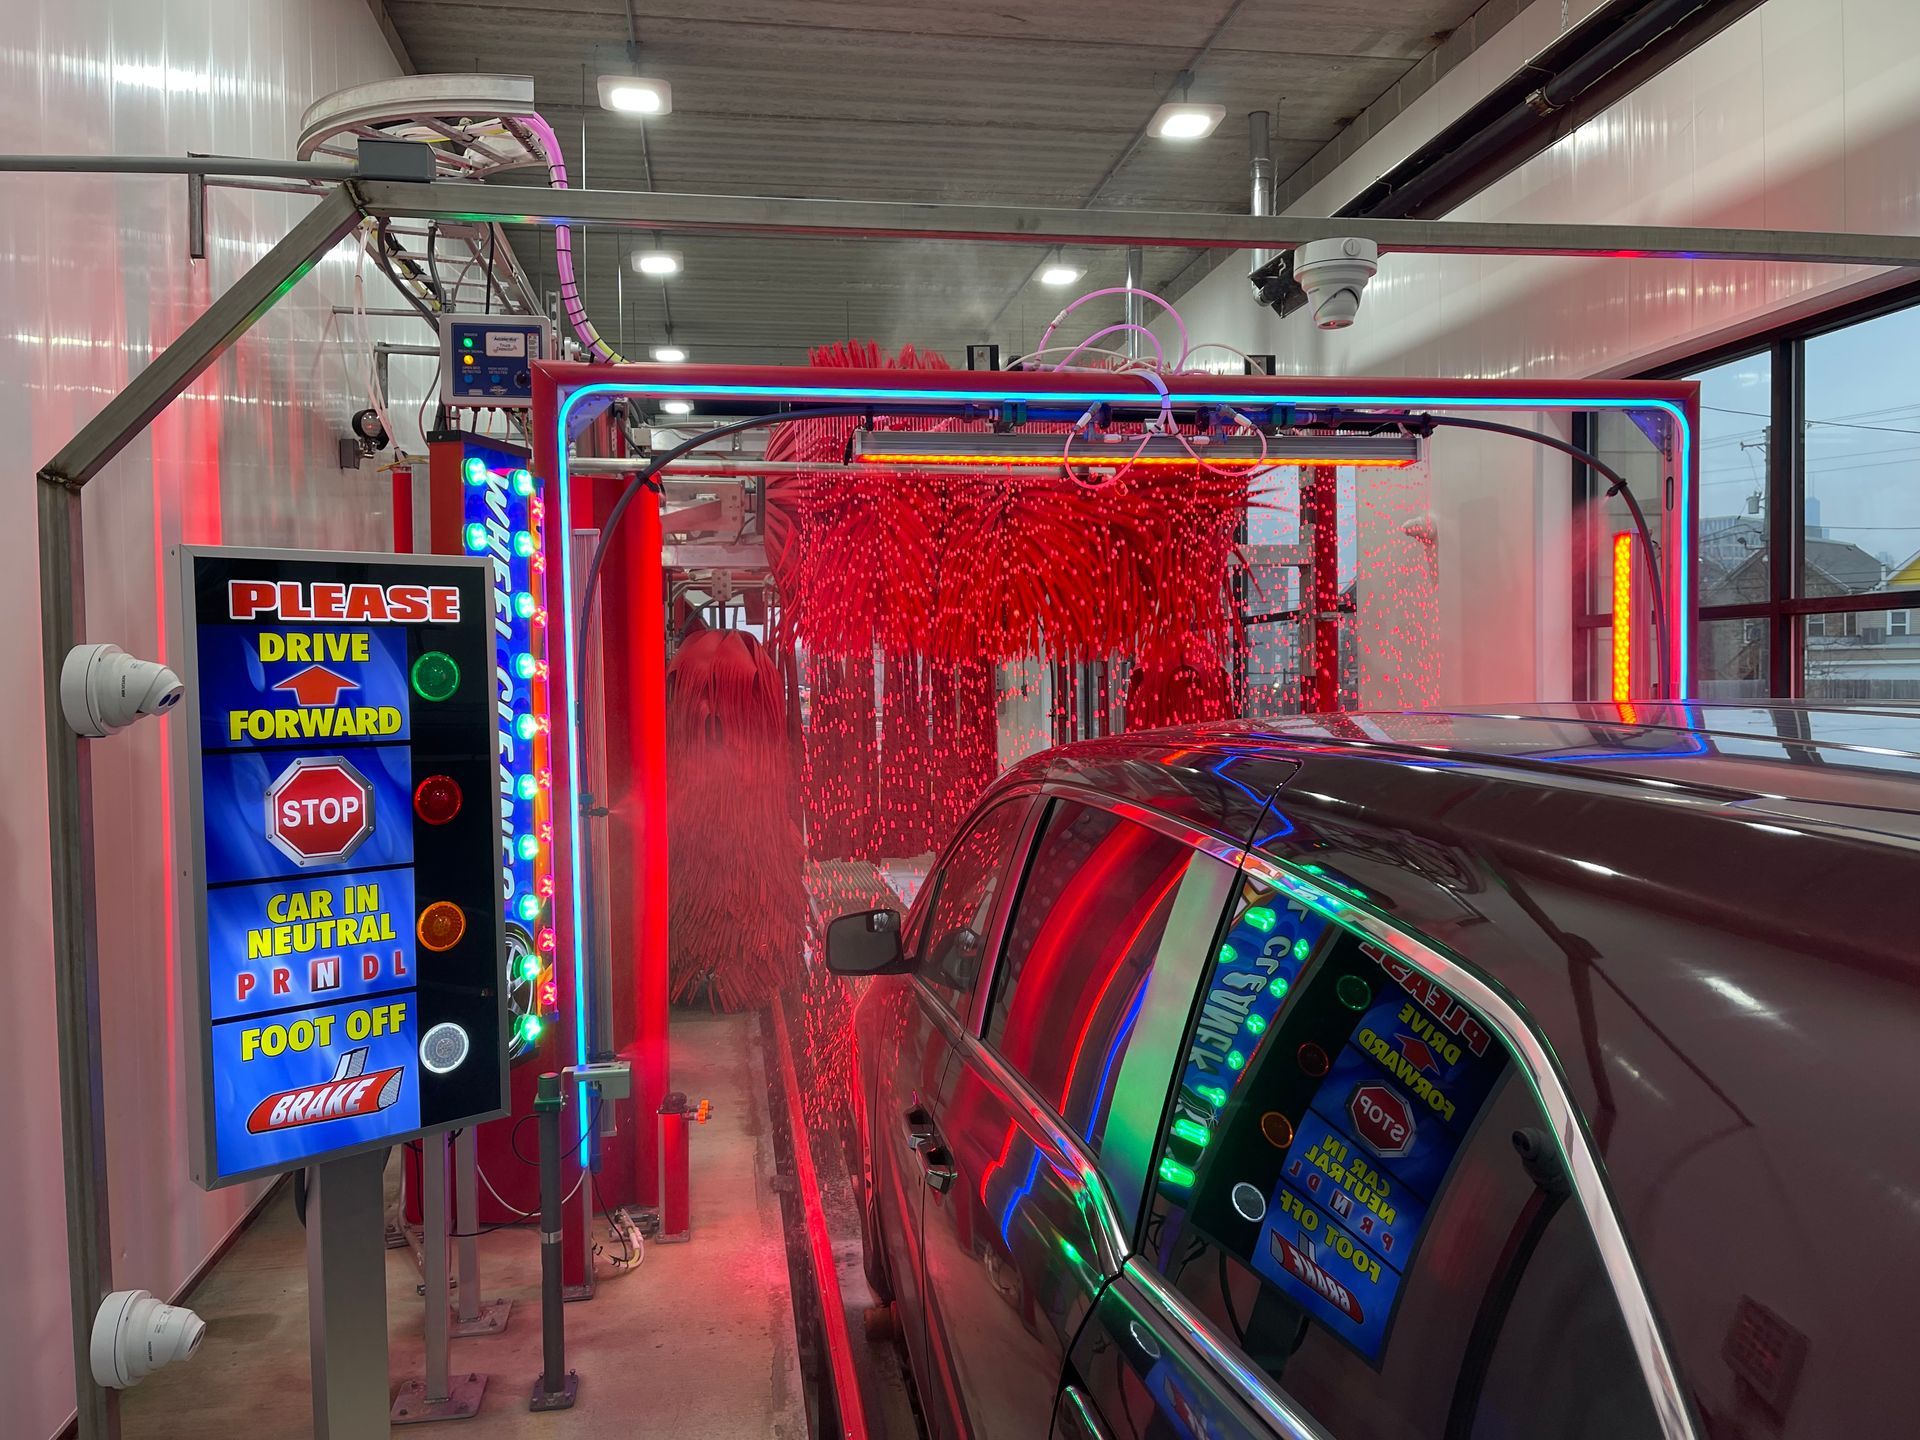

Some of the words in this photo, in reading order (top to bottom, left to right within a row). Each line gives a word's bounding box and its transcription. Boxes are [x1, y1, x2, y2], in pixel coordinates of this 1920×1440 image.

[228, 580, 461, 622] PLEASE
[259, 632, 369, 662] DRIVE
[229, 706, 402, 741] FORWARD
[282, 797, 359, 827] STOP
[266, 889, 333, 924] CAR
[344, 884, 380, 914] IN
[247, 911, 396, 960] NEUTRAL
[237, 973, 255, 1001] P
[273, 968, 290, 995] R
[316, 960, 335, 989] N
[363, 955, 379, 980] D
[394, 950, 406, 976] L
[241, 1015, 336, 1062] FOOT
[345, 1002, 407, 1041] OFF
[269, 1076, 378, 1127] BRAKE
